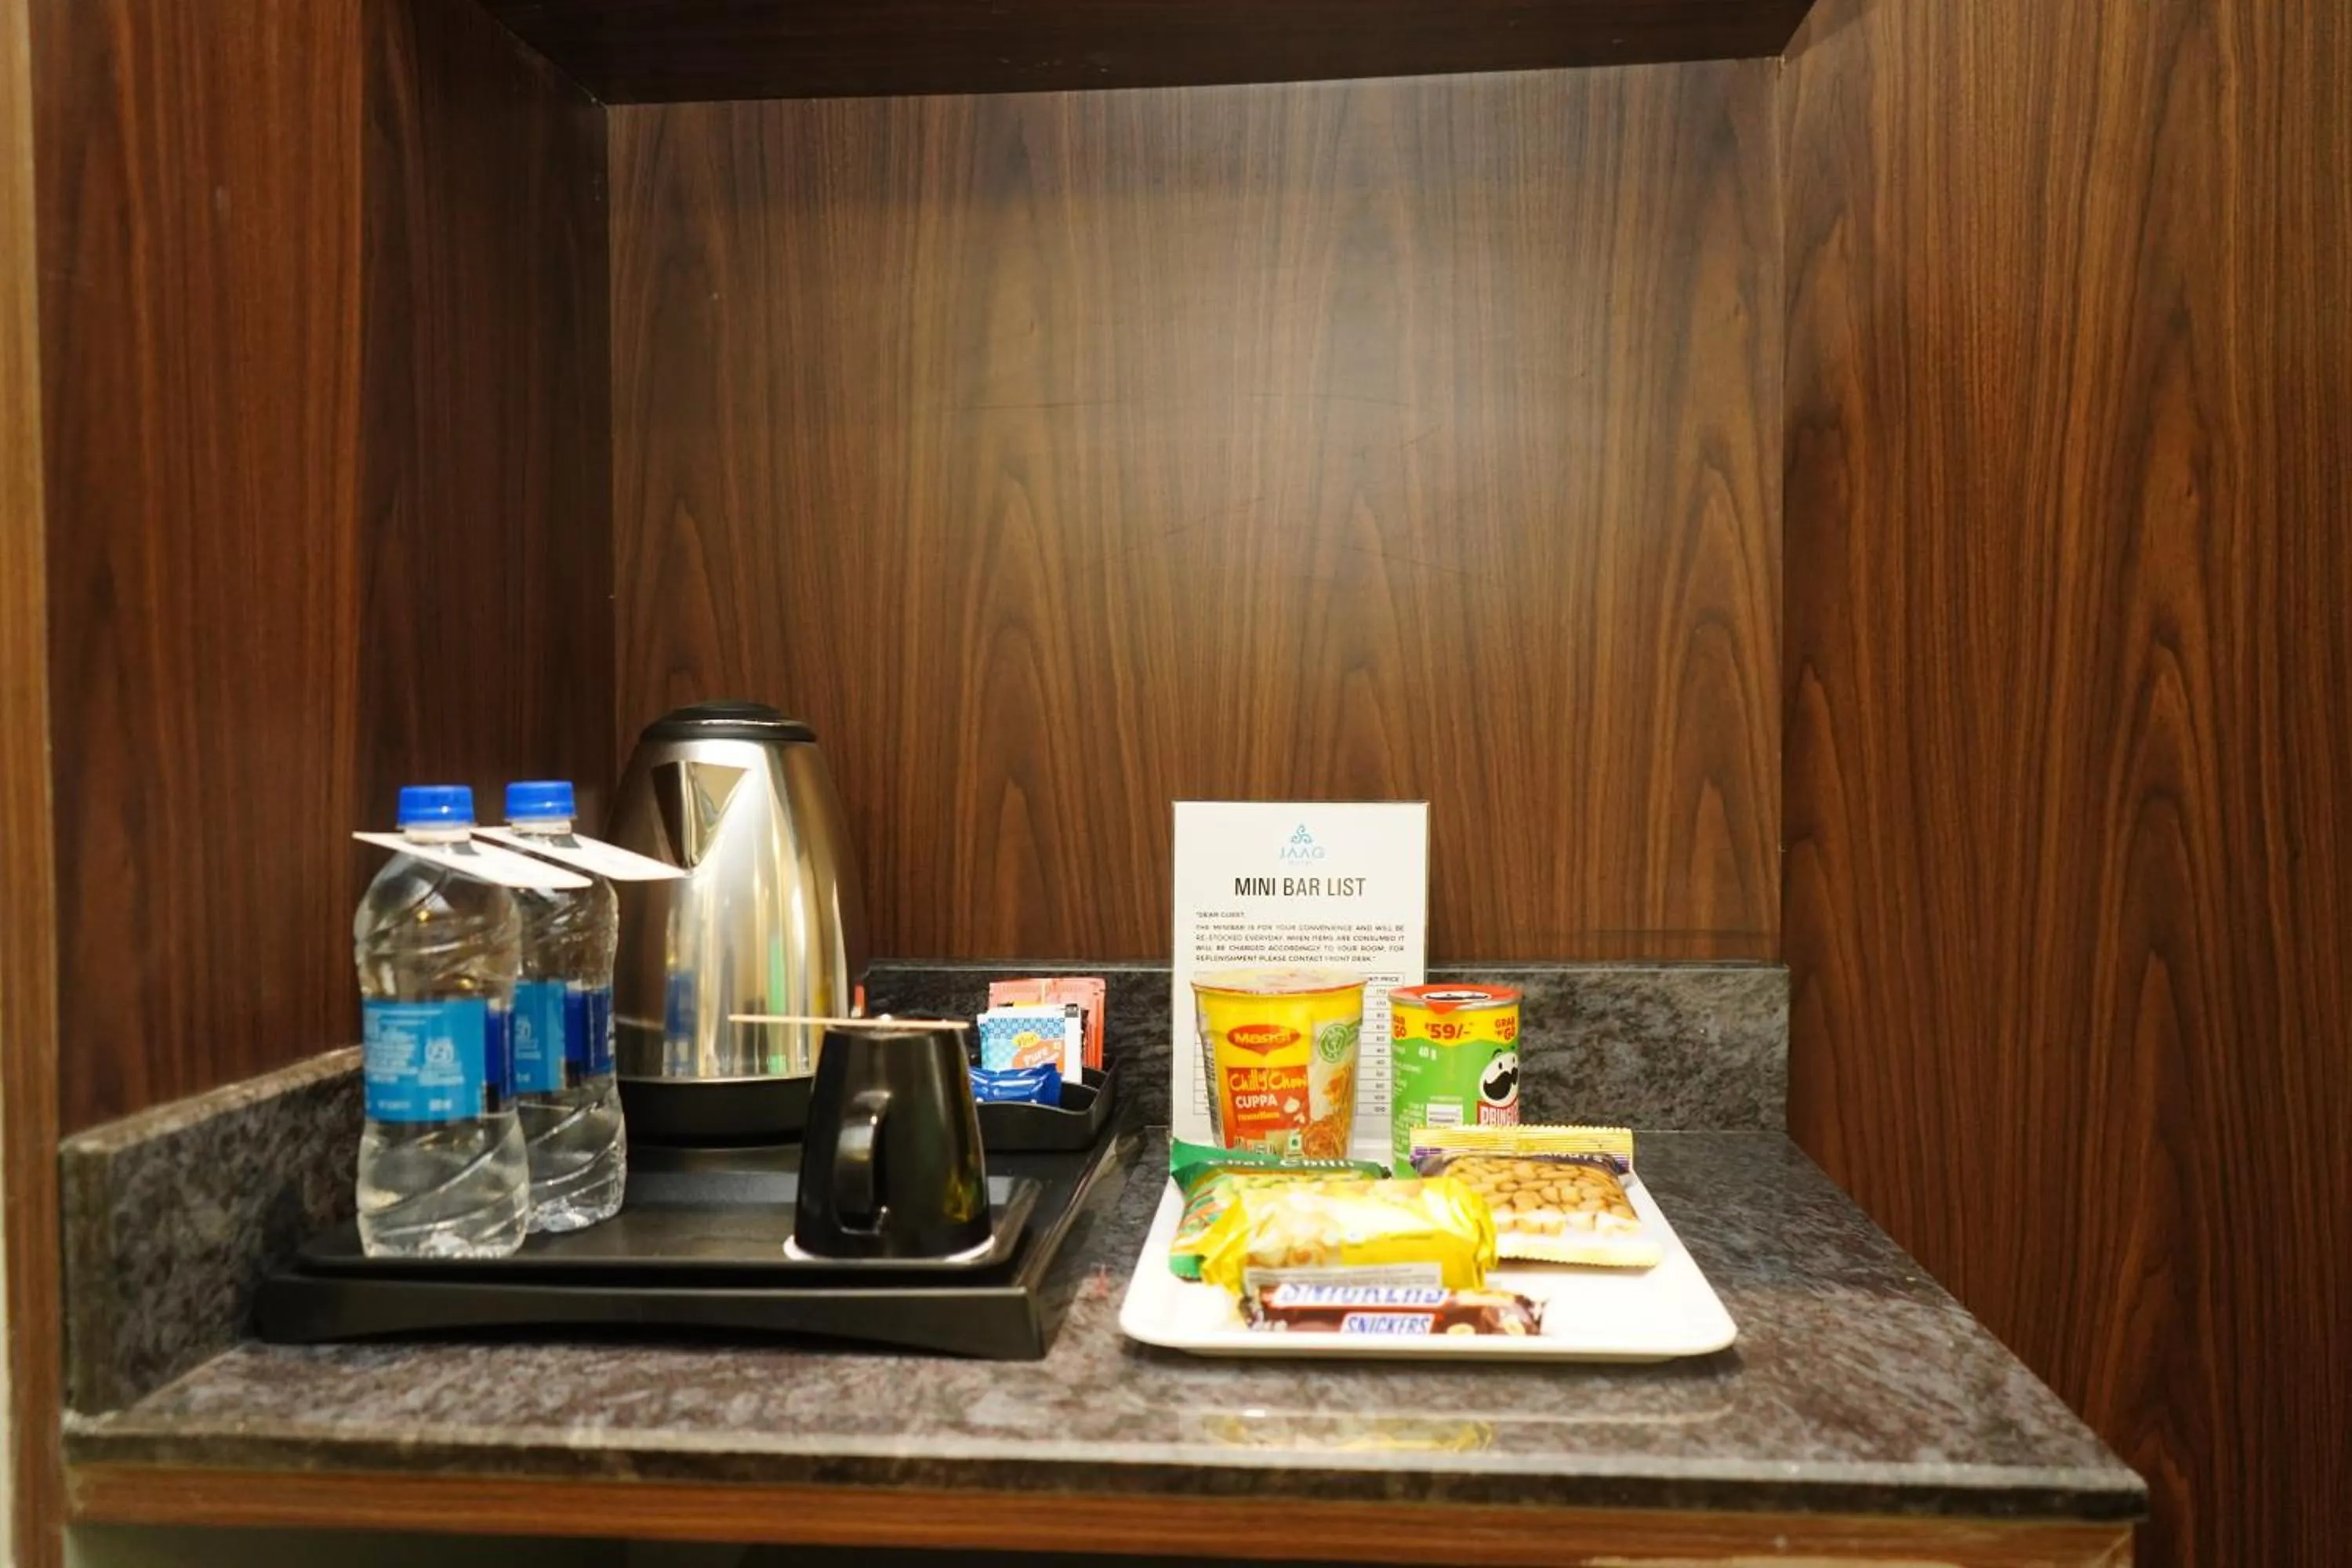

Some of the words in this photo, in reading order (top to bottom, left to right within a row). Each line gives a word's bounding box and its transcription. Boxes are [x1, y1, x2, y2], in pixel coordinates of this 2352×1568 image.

[1235, 877, 1276, 896] MINI
[1283, 877, 1320, 896] BAR
[1327, 877, 1367, 896] LIST
[1236, 1094, 1278, 1109] CUPPA
[1347, 1316, 1430, 1334] SNICKERS
